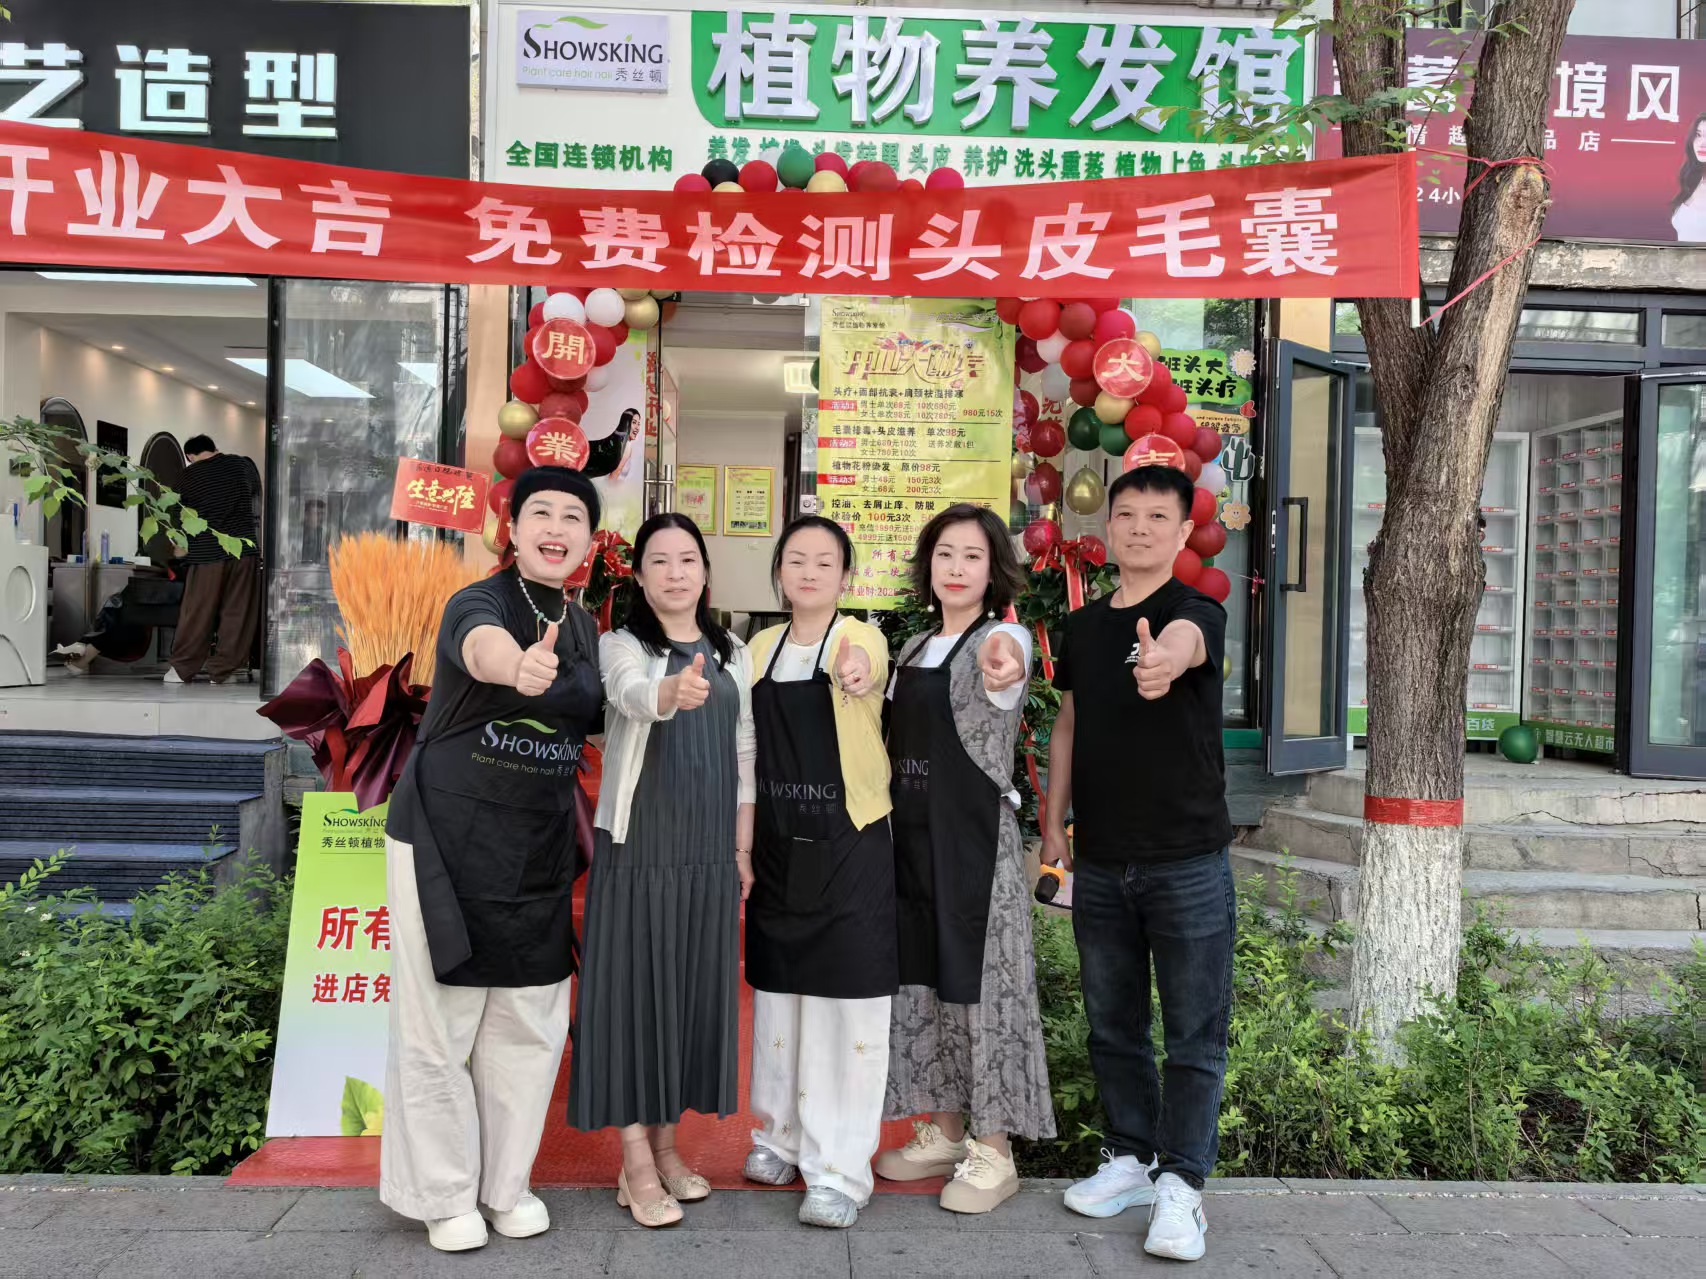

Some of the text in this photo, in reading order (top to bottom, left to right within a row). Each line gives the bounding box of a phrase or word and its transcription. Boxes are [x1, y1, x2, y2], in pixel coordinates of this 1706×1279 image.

[523, 28, 663, 64] SHOWSKING
[552, 70, 572, 78] care
[615, 67, 662, 83] 秀丝顿
[707, 10, 1301, 134] 植物养发馆
[0, 42, 338, 139] 艺造型
[1407, 124, 1600, 152] 情趣品店
[506, 140, 673, 173] 全国连锁机构
[0, 144, 1339, 282] 开业大吉 免费检测头皮毛囊
[542, 331, 586, 365] 開
[1101, 352, 1145, 382] 大
[536, 431, 581, 463] 業
[471, 752, 495, 764] Plant
[496, 760, 519, 770] care
[322, 836, 386, 848] 秀丝顿植物
[316, 905, 391, 951] 所有
[311, 973, 391, 1004] 进店免
